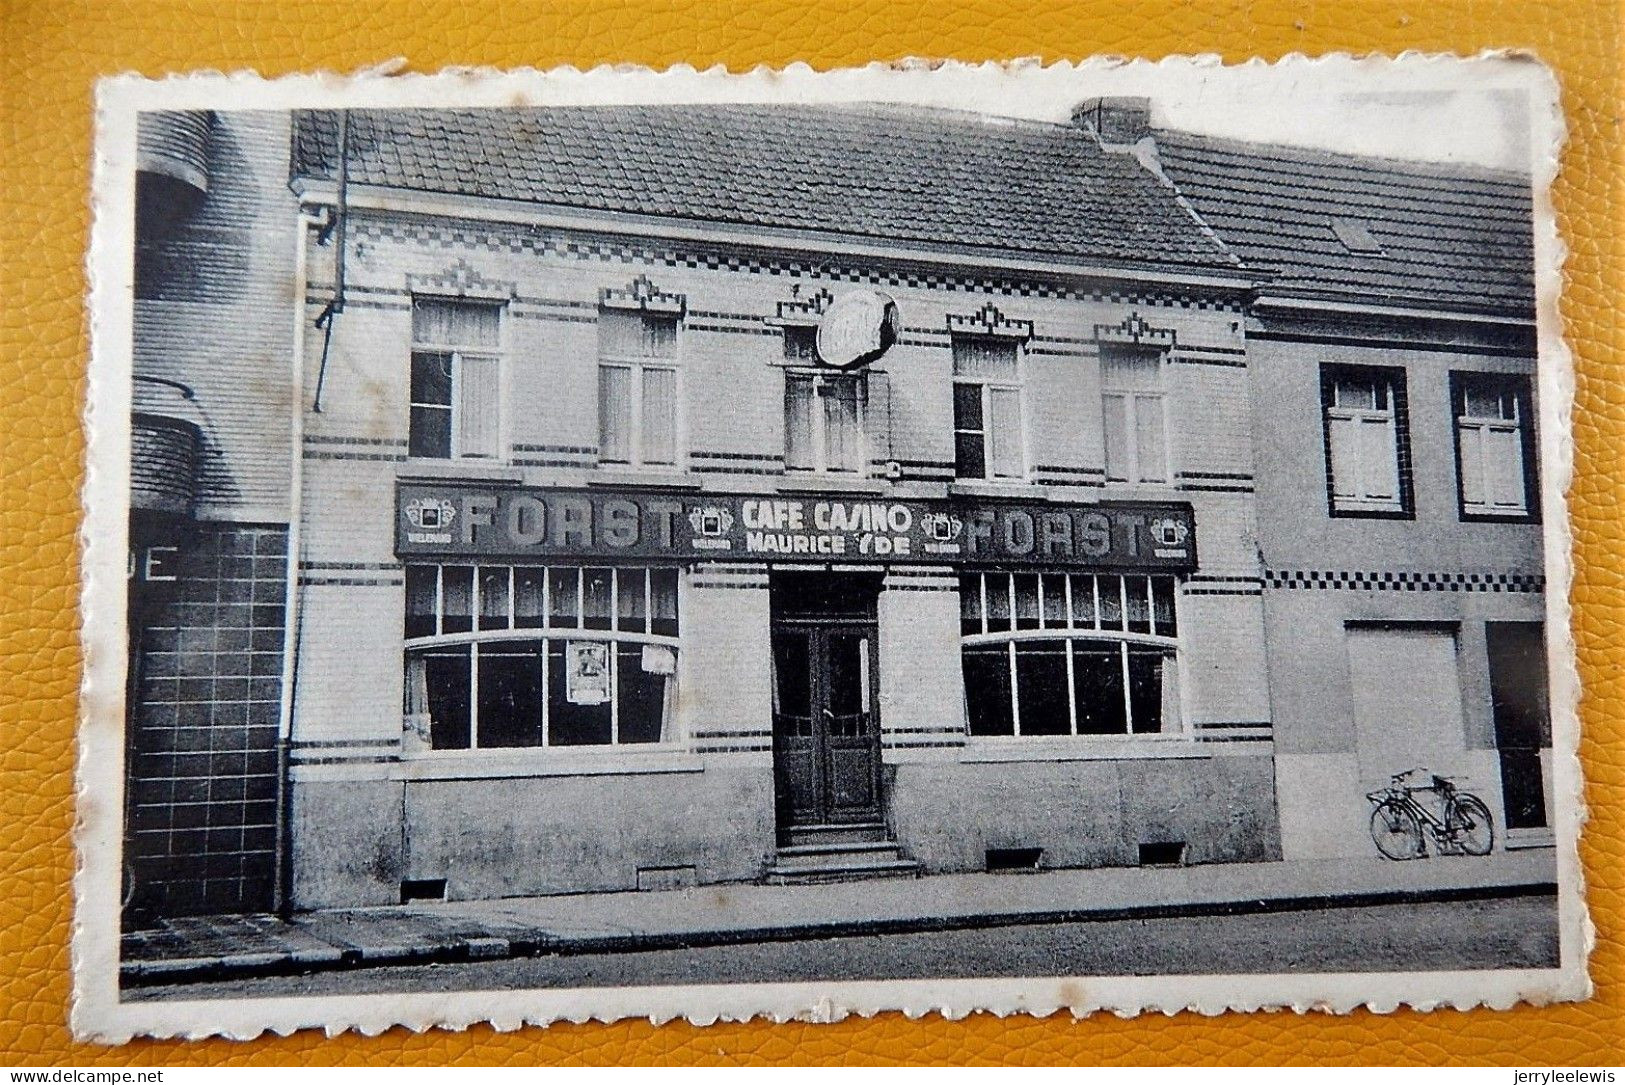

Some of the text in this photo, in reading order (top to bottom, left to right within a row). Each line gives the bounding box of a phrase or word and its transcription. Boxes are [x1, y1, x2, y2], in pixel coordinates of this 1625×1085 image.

[461, 494, 684, 548] FORST
[742, 500, 913, 533] CAFE CASINO
[967, 509, 1147, 557] FORST
[747, 532, 845, 554] MAURICE
